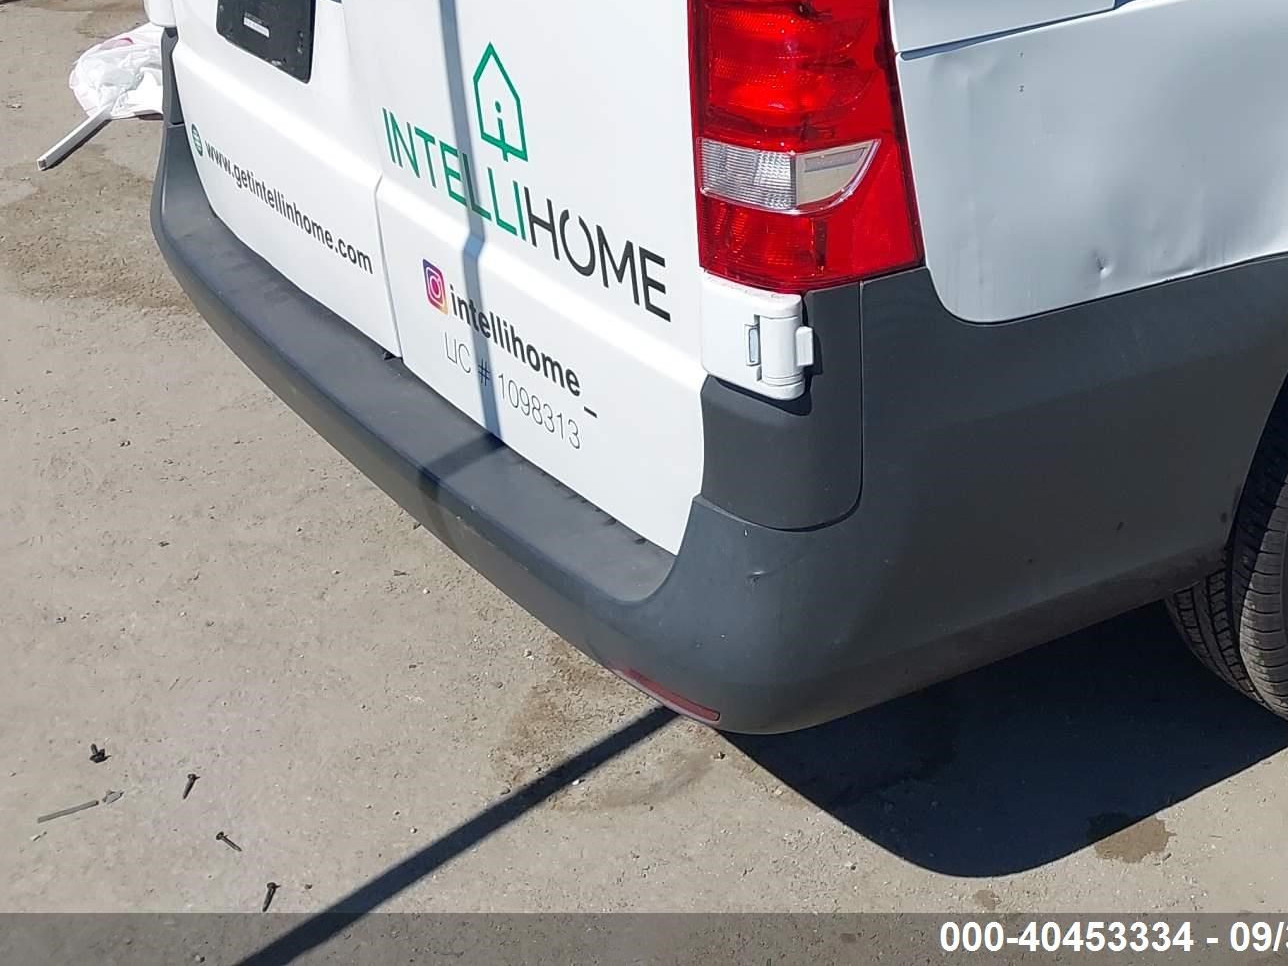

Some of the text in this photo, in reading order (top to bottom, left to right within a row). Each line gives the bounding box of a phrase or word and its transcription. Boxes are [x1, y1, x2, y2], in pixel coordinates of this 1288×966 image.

[203, 139, 374, 275] www.getintellinhome.com
[381, 107, 672, 323] INTELLIHOME
[444, 331, 581, 450] LIC # 1098313
